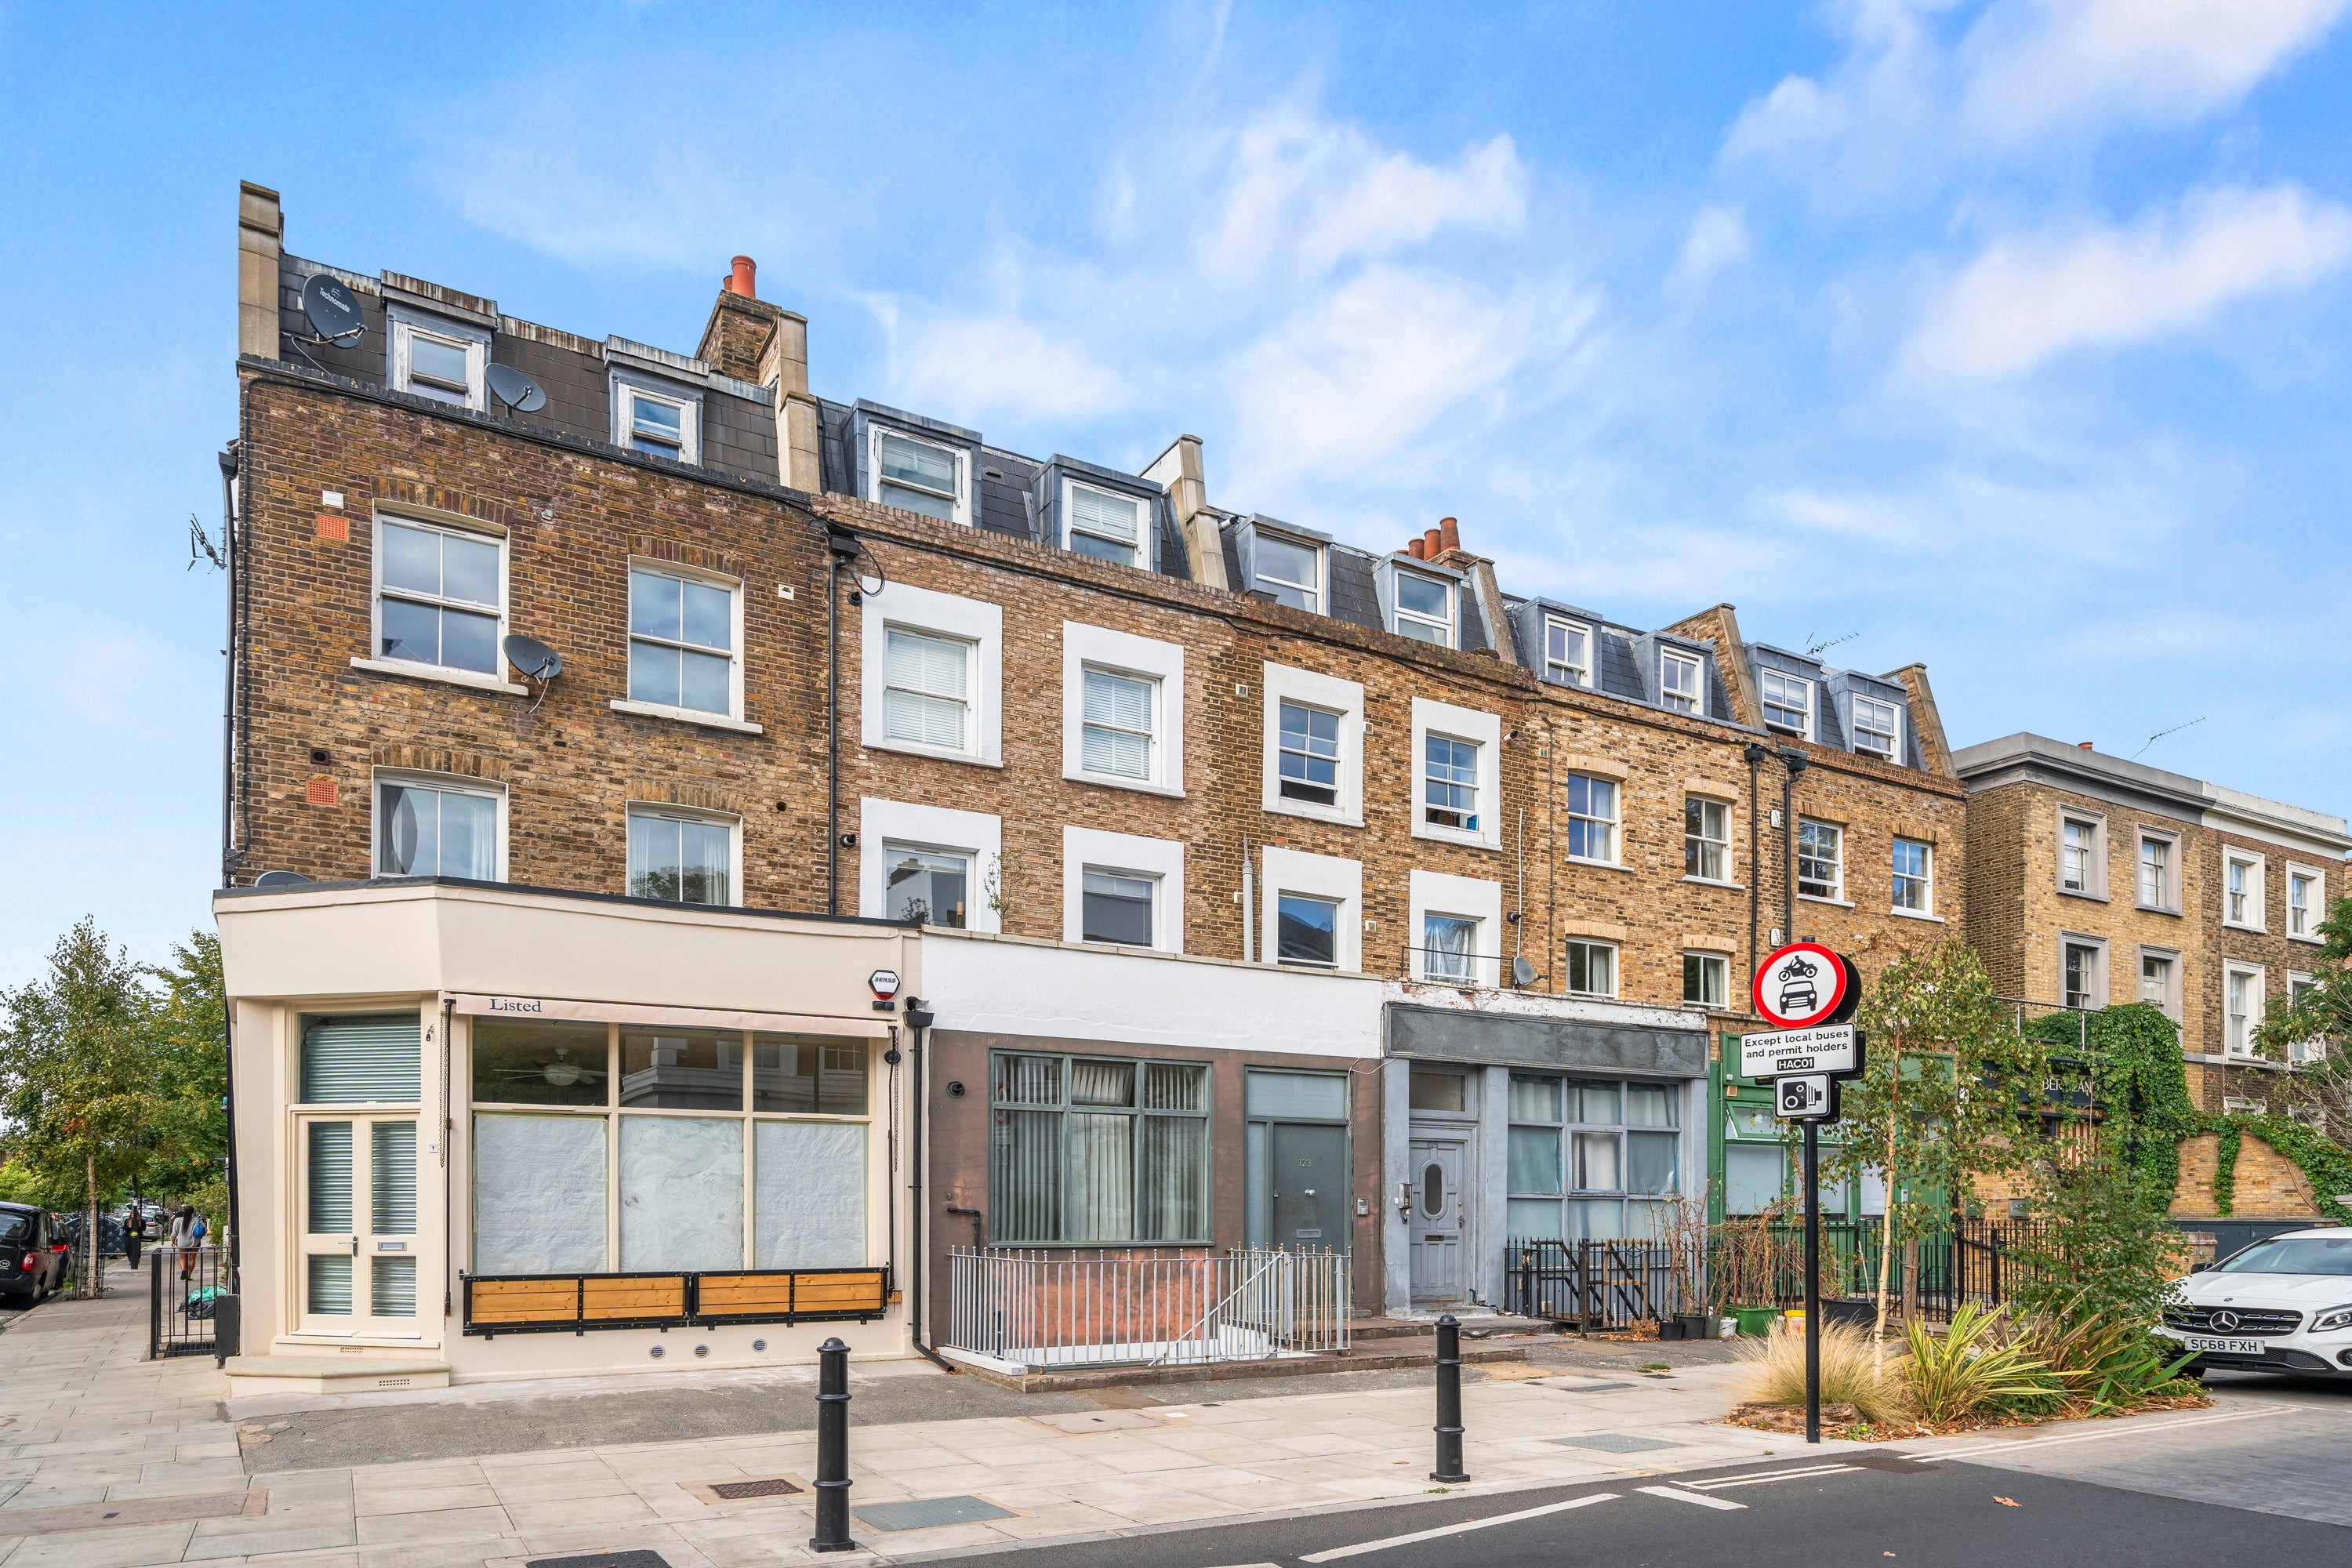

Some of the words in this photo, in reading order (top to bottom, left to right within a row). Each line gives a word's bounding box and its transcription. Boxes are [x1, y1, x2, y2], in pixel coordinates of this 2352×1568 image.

[320, 287, 350, 313] Technomate
[489, 998, 543, 1013] Listed
[1745, 1036, 1781, 1047] Except
[1785, 1033, 1812, 1044] local
[1817, 1029, 1849, 1040] buses
[1746, 1049, 1765, 1058] and
[1769, 1045, 1802, 1058] permit
[1806, 1043, 1848, 1053] holders
[1298, 1159, 1312, 1167] 123
[2190, 1338, 2226, 1350] SC68
[2229, 1341, 2258, 1352] FXH
